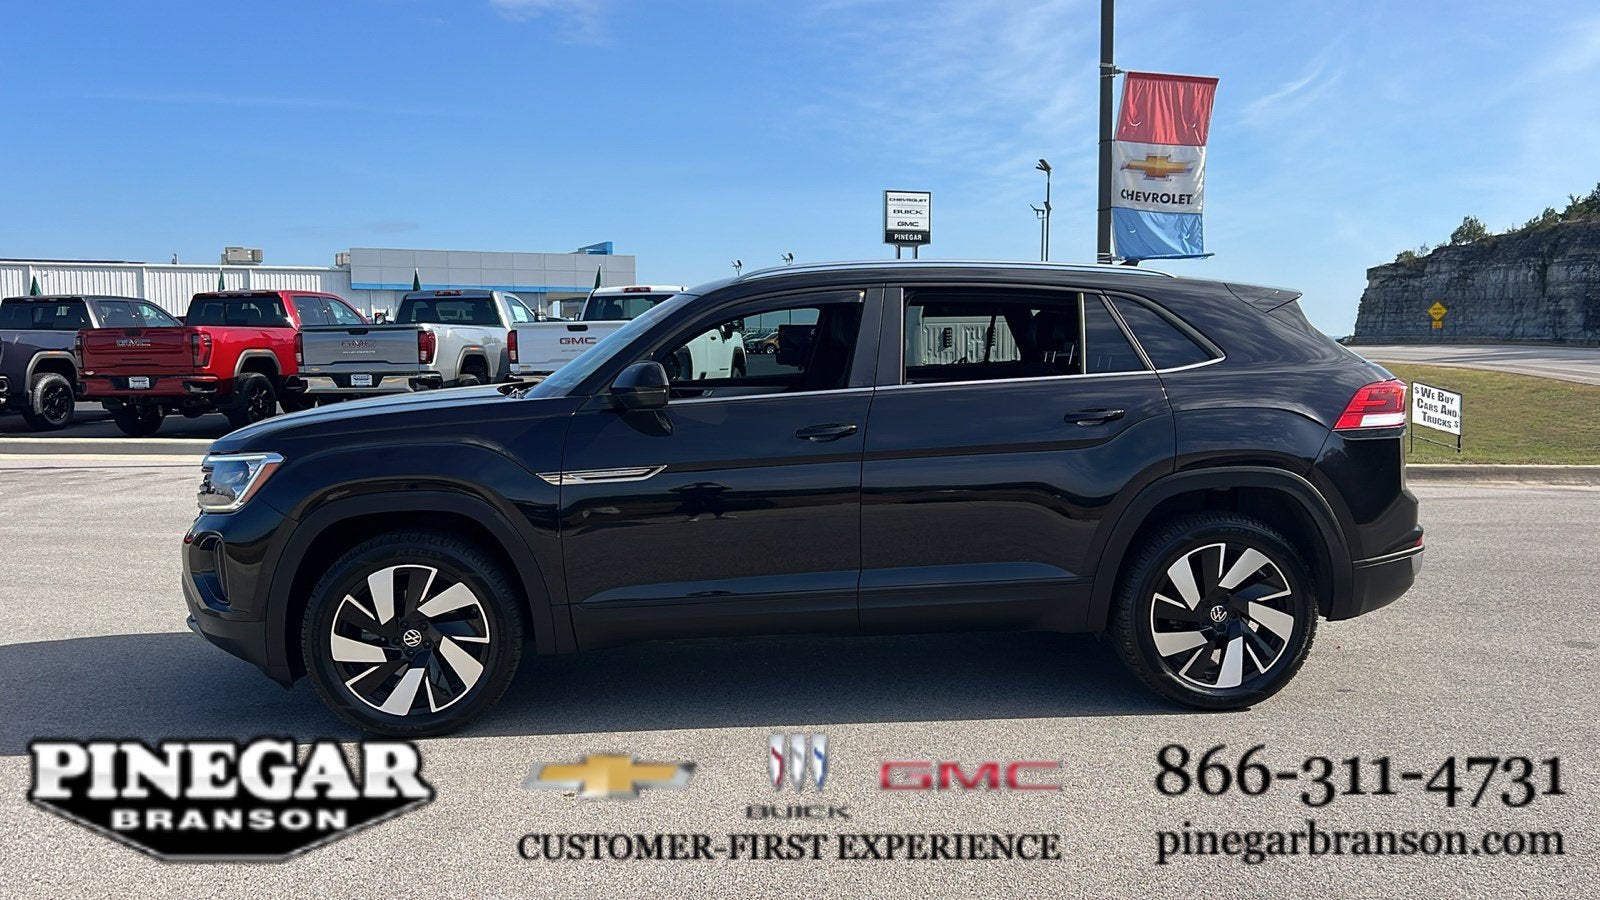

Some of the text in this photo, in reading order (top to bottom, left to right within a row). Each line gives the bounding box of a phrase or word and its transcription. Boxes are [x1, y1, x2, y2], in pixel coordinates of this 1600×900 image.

[1120, 188, 1193, 205] CHEVROLET
[894, 233, 922, 241] PINEGAR
[558, 336, 598, 346] GMC
